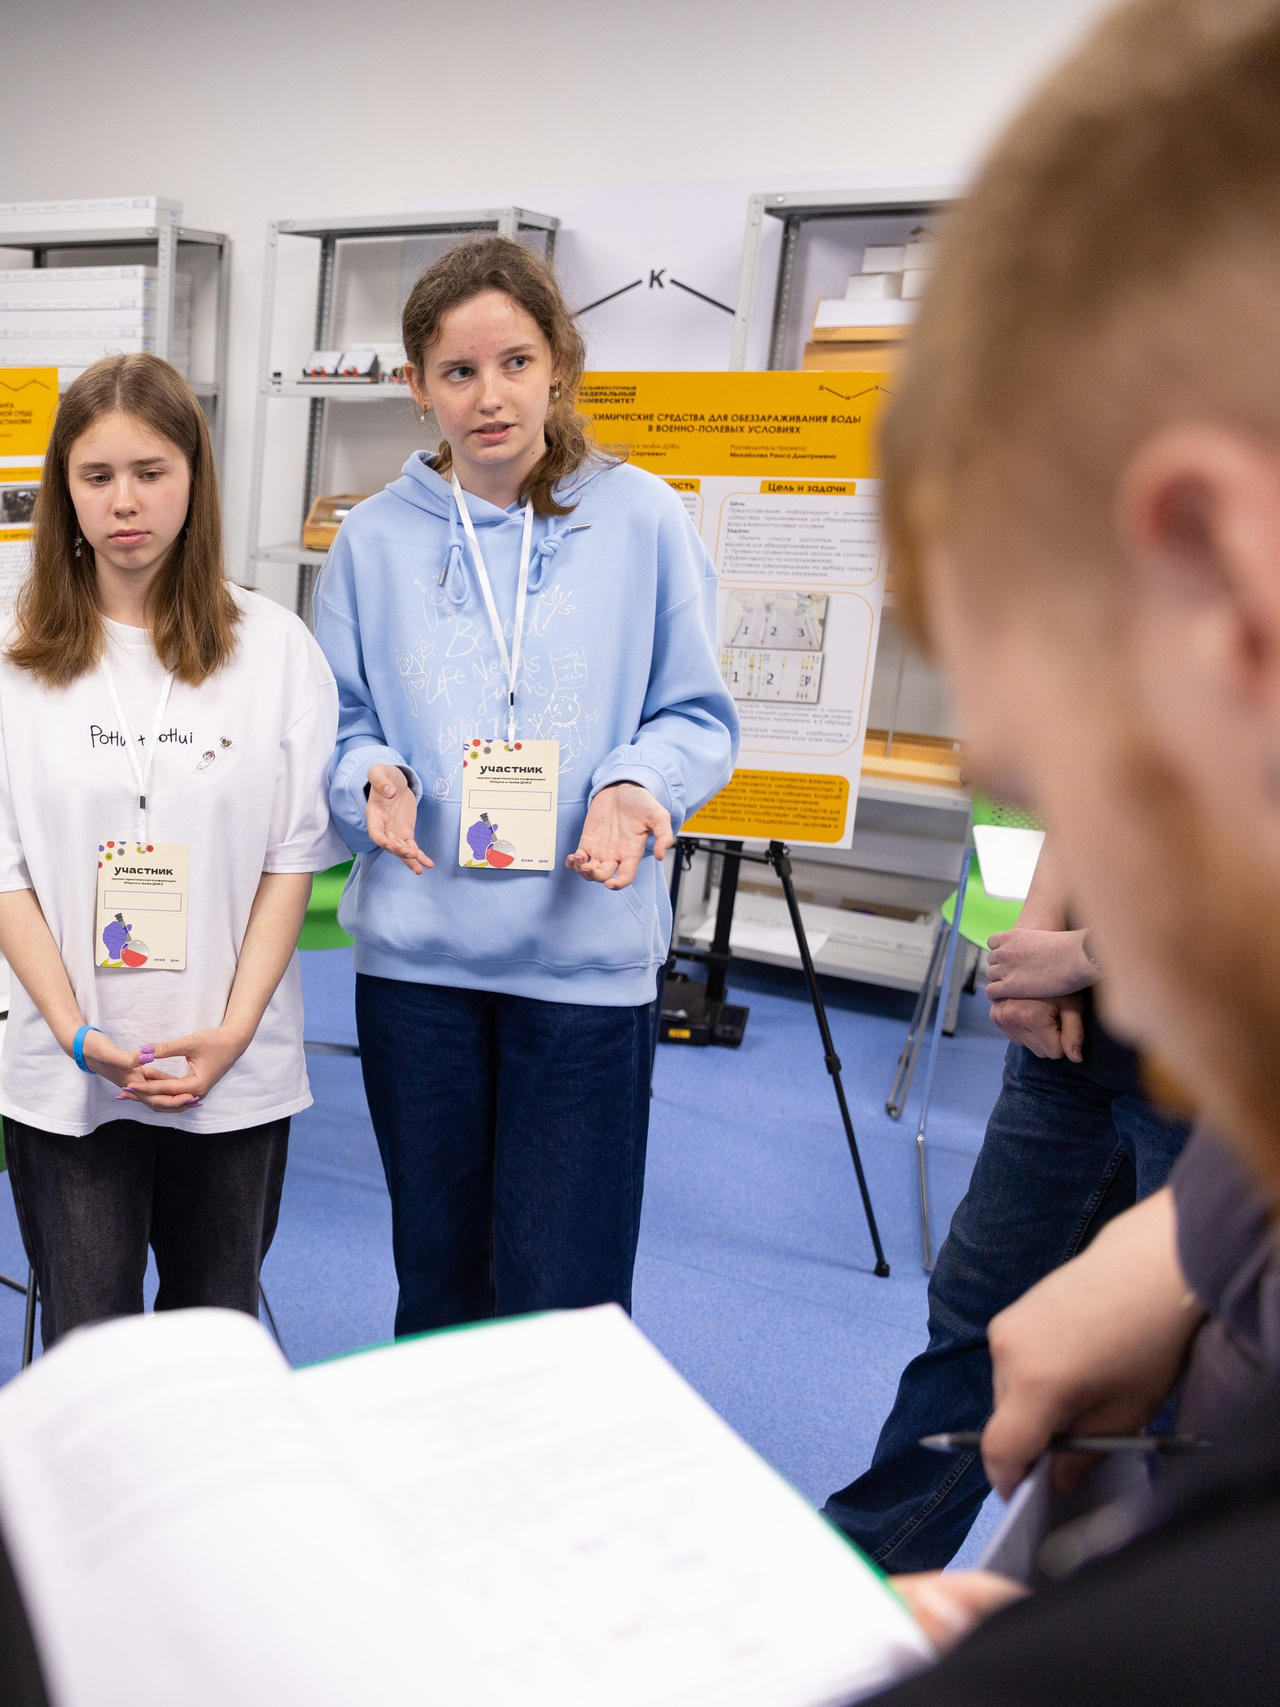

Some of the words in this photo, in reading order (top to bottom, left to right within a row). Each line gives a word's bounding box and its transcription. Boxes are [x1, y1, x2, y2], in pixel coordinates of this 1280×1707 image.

[592, 413, 654, 422] ХИМИЧЕСКИЕ
[657, 413, 705, 422] СРЕДСТВА
[708, 414, 728, 423] ДЛЯ
[731, 414, 828, 423] ОБЕЗЗАРАЖИВАНИЯ
[831, 415, 861, 424] ВОДЫ
[656, 425, 745, 434] ВОЕННО-ПОЛЕВЫХ
[748, 426, 801, 434] УСЛОВИЯХ
[768, 482, 795, 493] Цель
[798, 484, 803, 492] и
[807, 484, 846, 493] задачи
[770, 627, 778, 636] 2
[798, 628, 805, 637] 3
[733, 671, 739, 683] 1
[766, 673, 774, 685] 2
[480, 765, 543, 775] участник
[114, 866, 174, 876] участник
